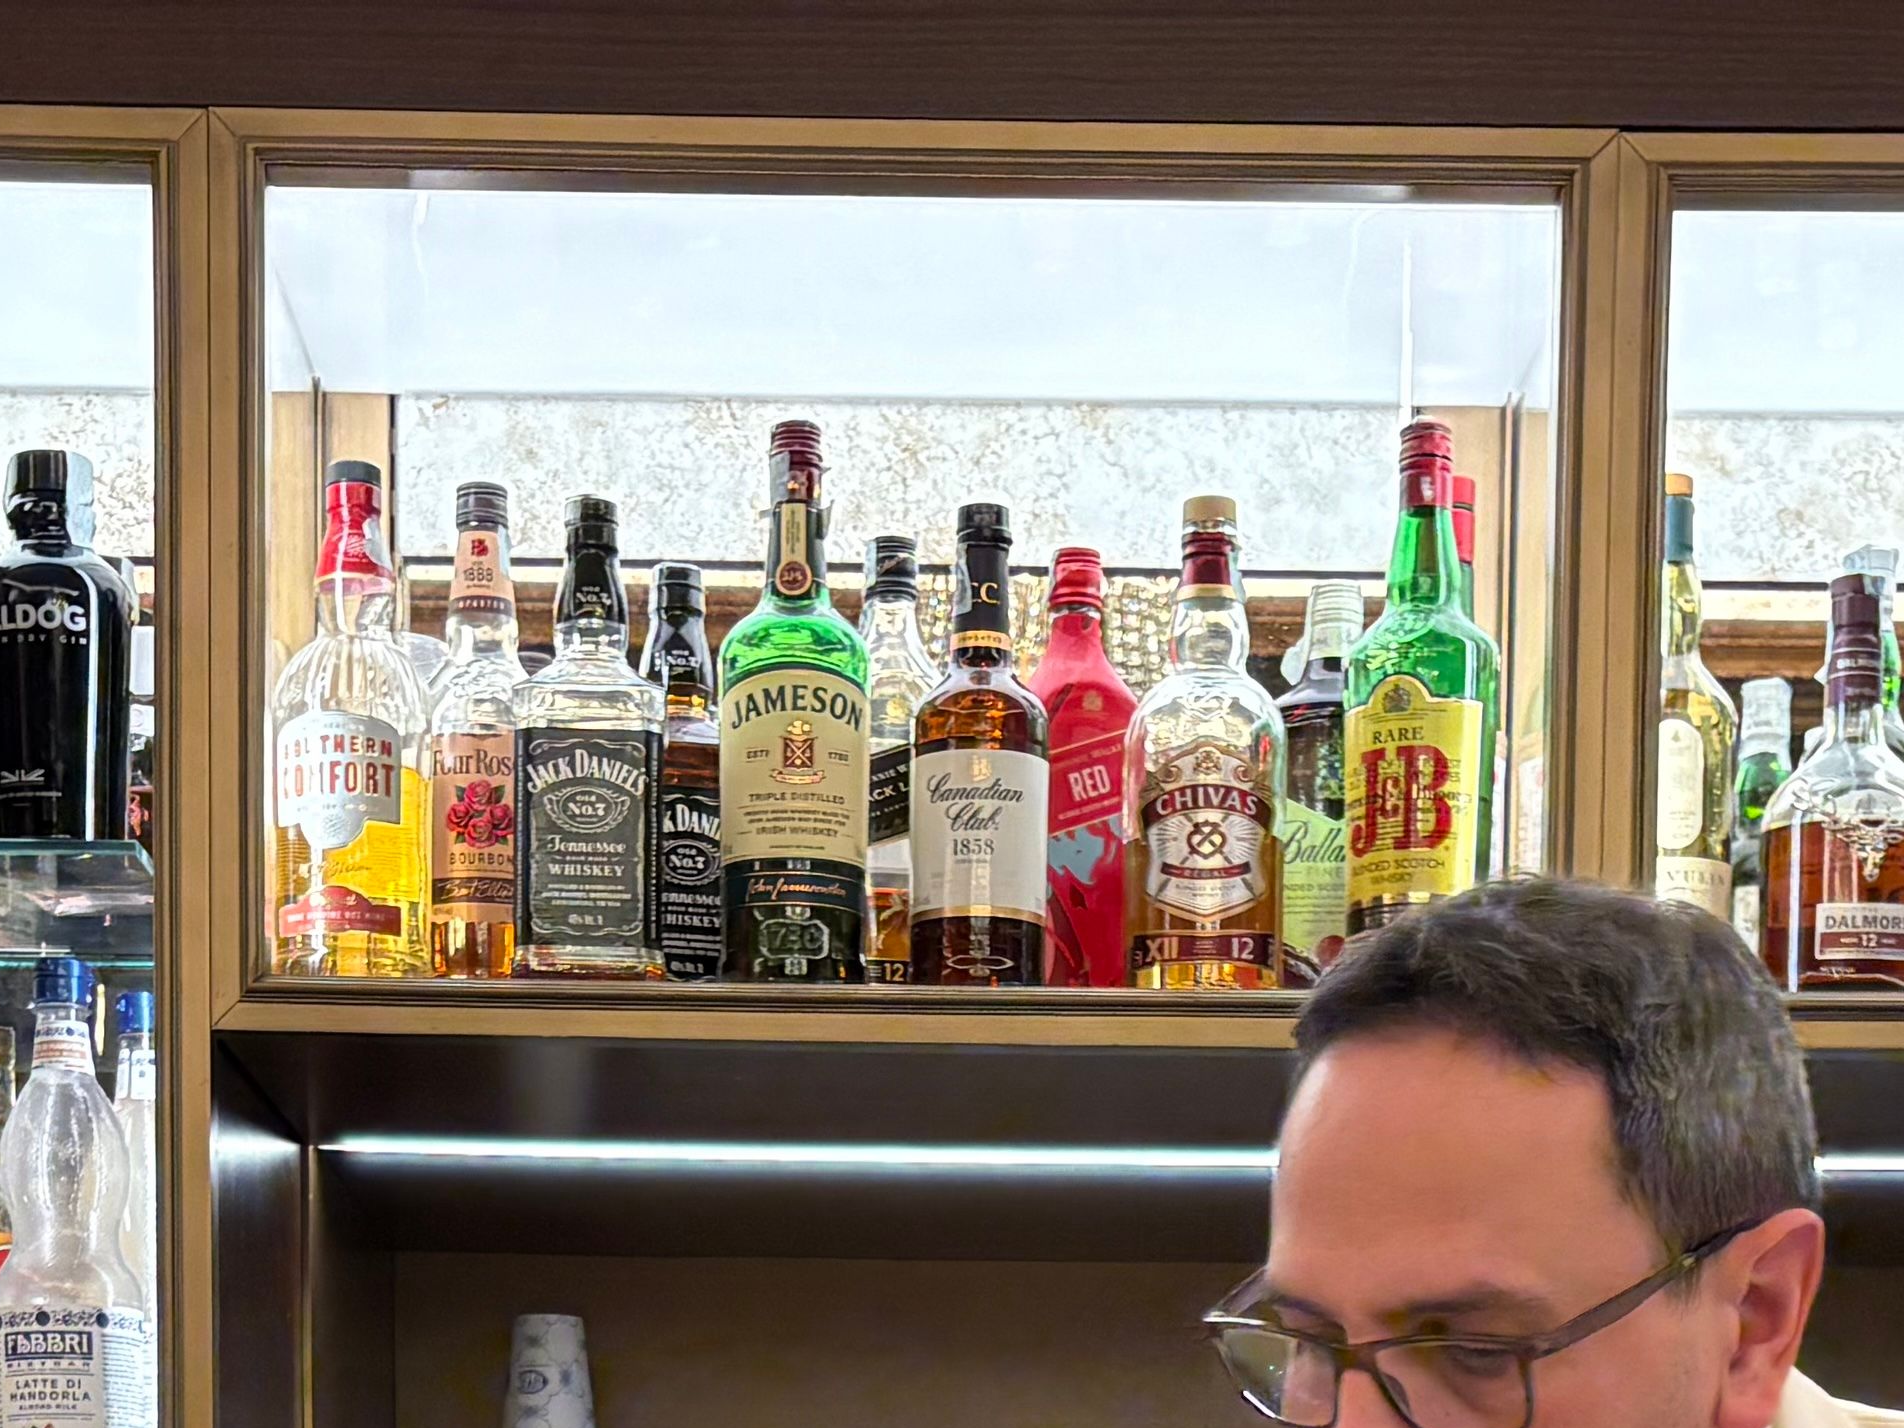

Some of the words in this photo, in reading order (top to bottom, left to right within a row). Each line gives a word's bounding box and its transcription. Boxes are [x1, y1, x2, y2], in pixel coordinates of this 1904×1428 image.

[732, 684, 863, 733] JAMESON
[1372, 726, 1424, 745] RARE
[433, 749, 473, 779] Four
[526, 756, 573, 796] JACK
[1068, 765, 1111, 802] RED
[927, 772, 1024, 804] Canadian
[566, 800, 606, 818] No.7
[748, 792, 787, 802] TRIPLE
[790, 792, 846, 806] DISTILLED
[1155, 786, 1260, 817] CHIVAS
[756, 825, 786, 836] IRISH
[547, 834, 627, 855] Tennessee
[951, 837, 995, 858] 1858
[449, 852, 515, 867] BOURBON
[547, 862, 626, 878] WHISKEY
[667, 853, 706, 871] No.7
[1667, 868, 1726, 886] VULIN
[1146, 937, 1179, 963] XII
[1232, 937, 1255, 960] 12
[884, 962, 906, 983] 12
[6, 1332, 89, 1356] FABBRI
[15, 1378, 59, 1391] LATTE
[66, 1378, 82, 1390] DI
[9, 1390, 92, 1402] MANDORLA
